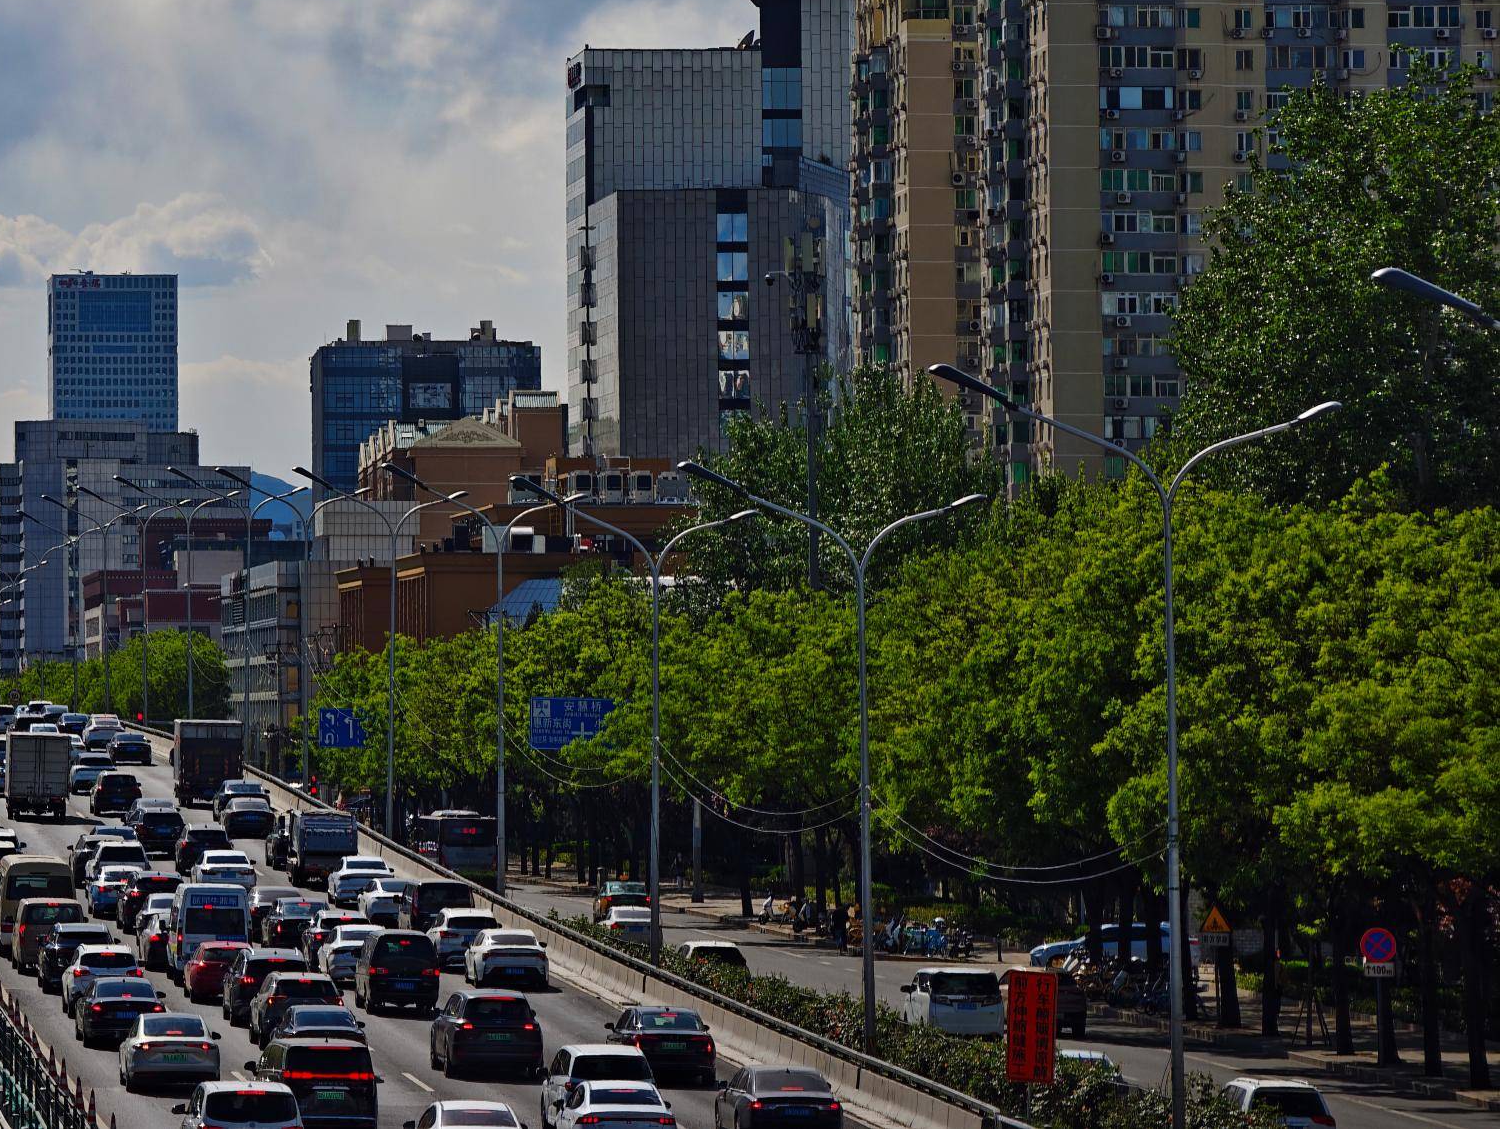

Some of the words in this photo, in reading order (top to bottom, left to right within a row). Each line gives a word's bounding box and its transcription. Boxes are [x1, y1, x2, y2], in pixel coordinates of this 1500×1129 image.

[564, 701, 601, 712] 安慧桥
[533, 717, 572, 729] 惠新东街
